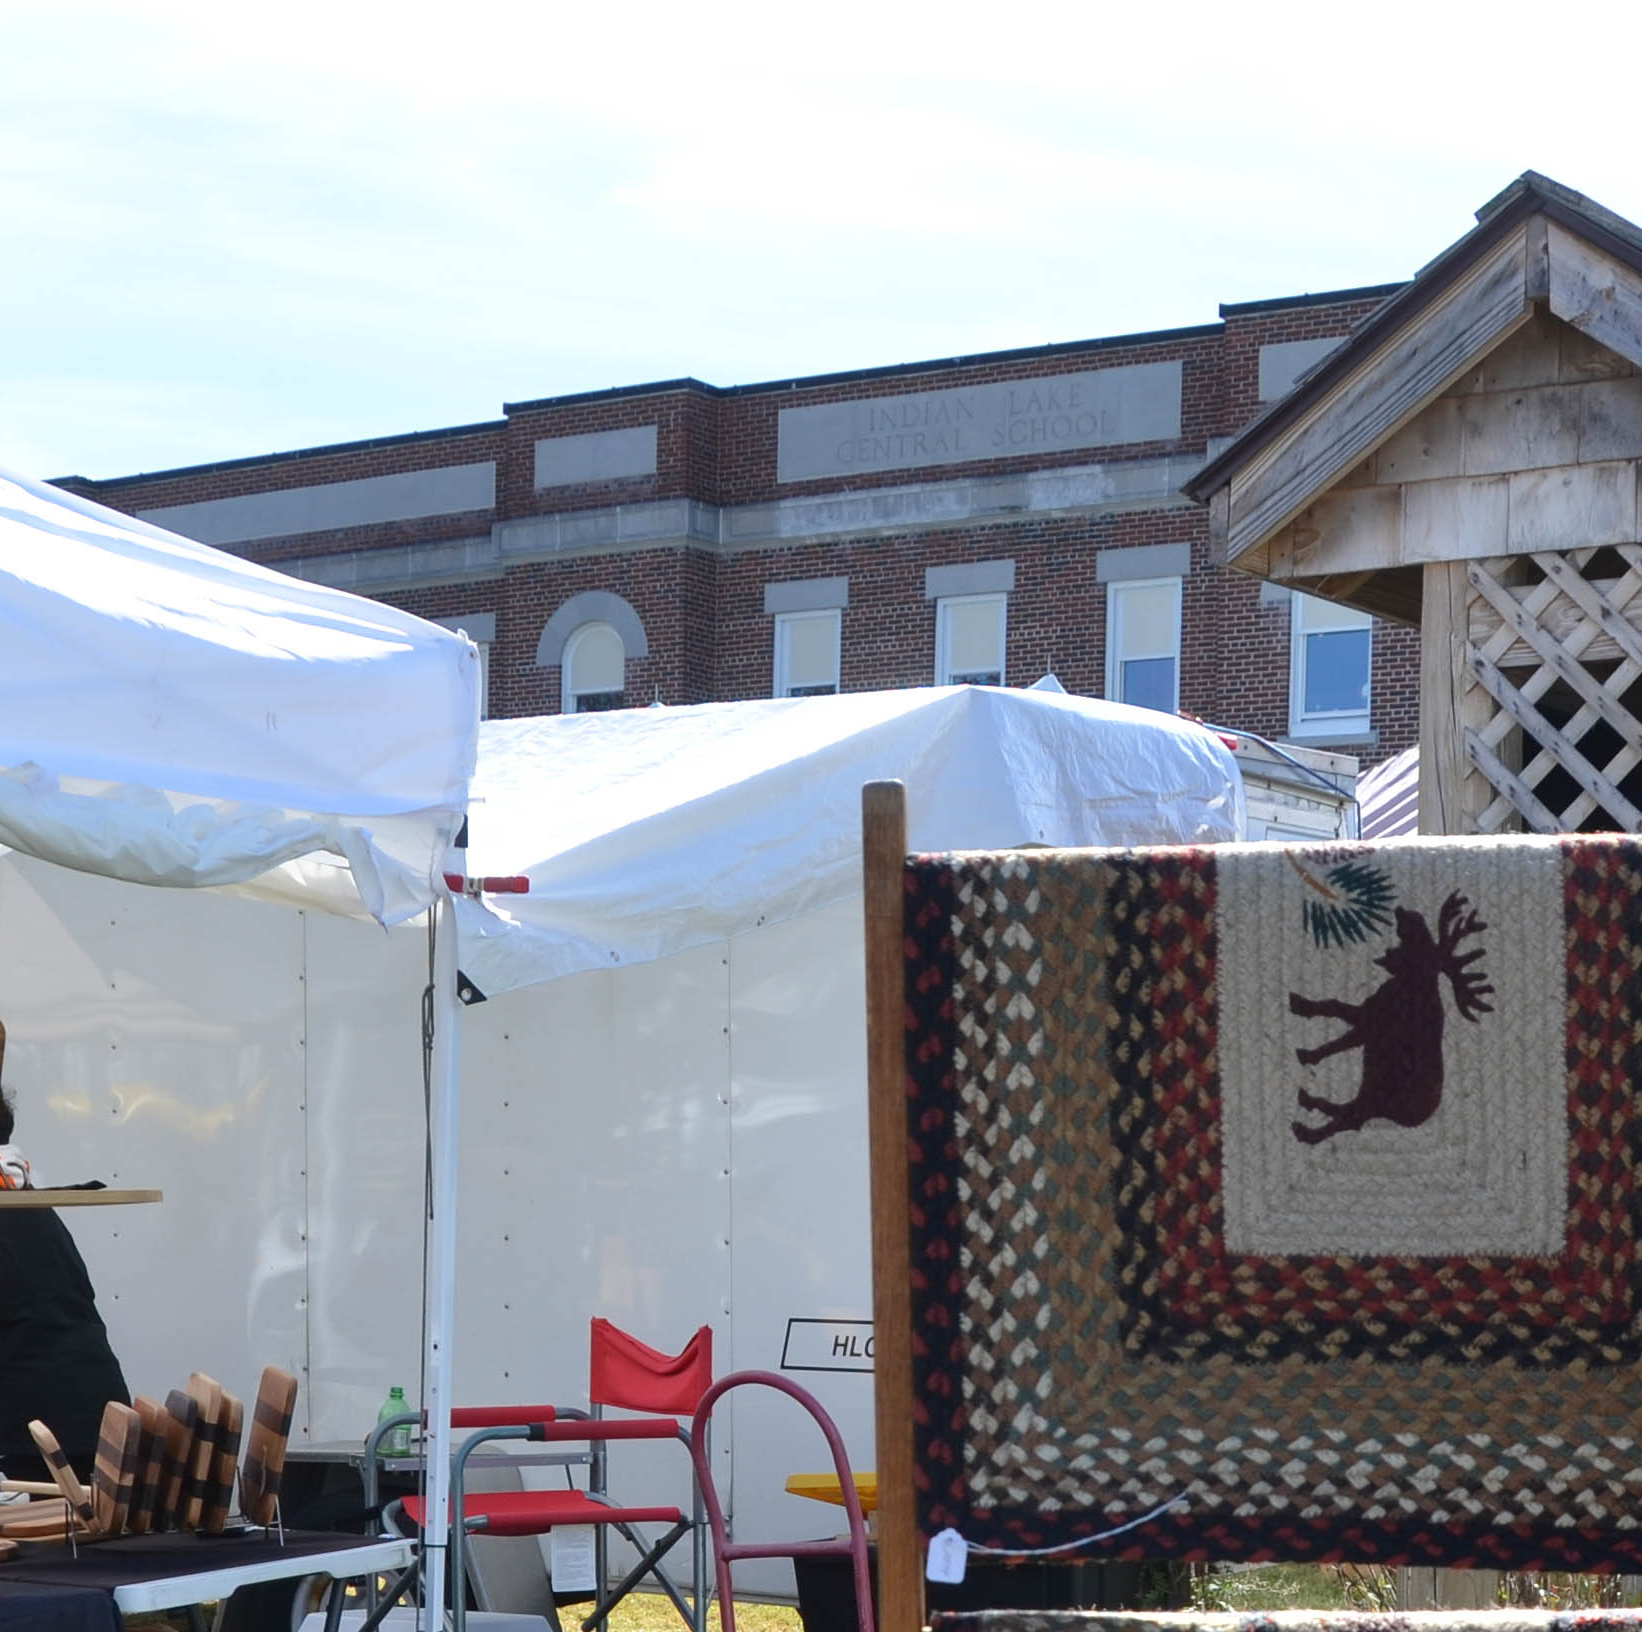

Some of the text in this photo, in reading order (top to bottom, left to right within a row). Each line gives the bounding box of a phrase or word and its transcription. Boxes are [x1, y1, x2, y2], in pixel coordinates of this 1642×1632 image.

[868, 382, 1084, 433] INDIAN LAKE
[836, 409, 1114, 465] CENTRAL SCHOOL
